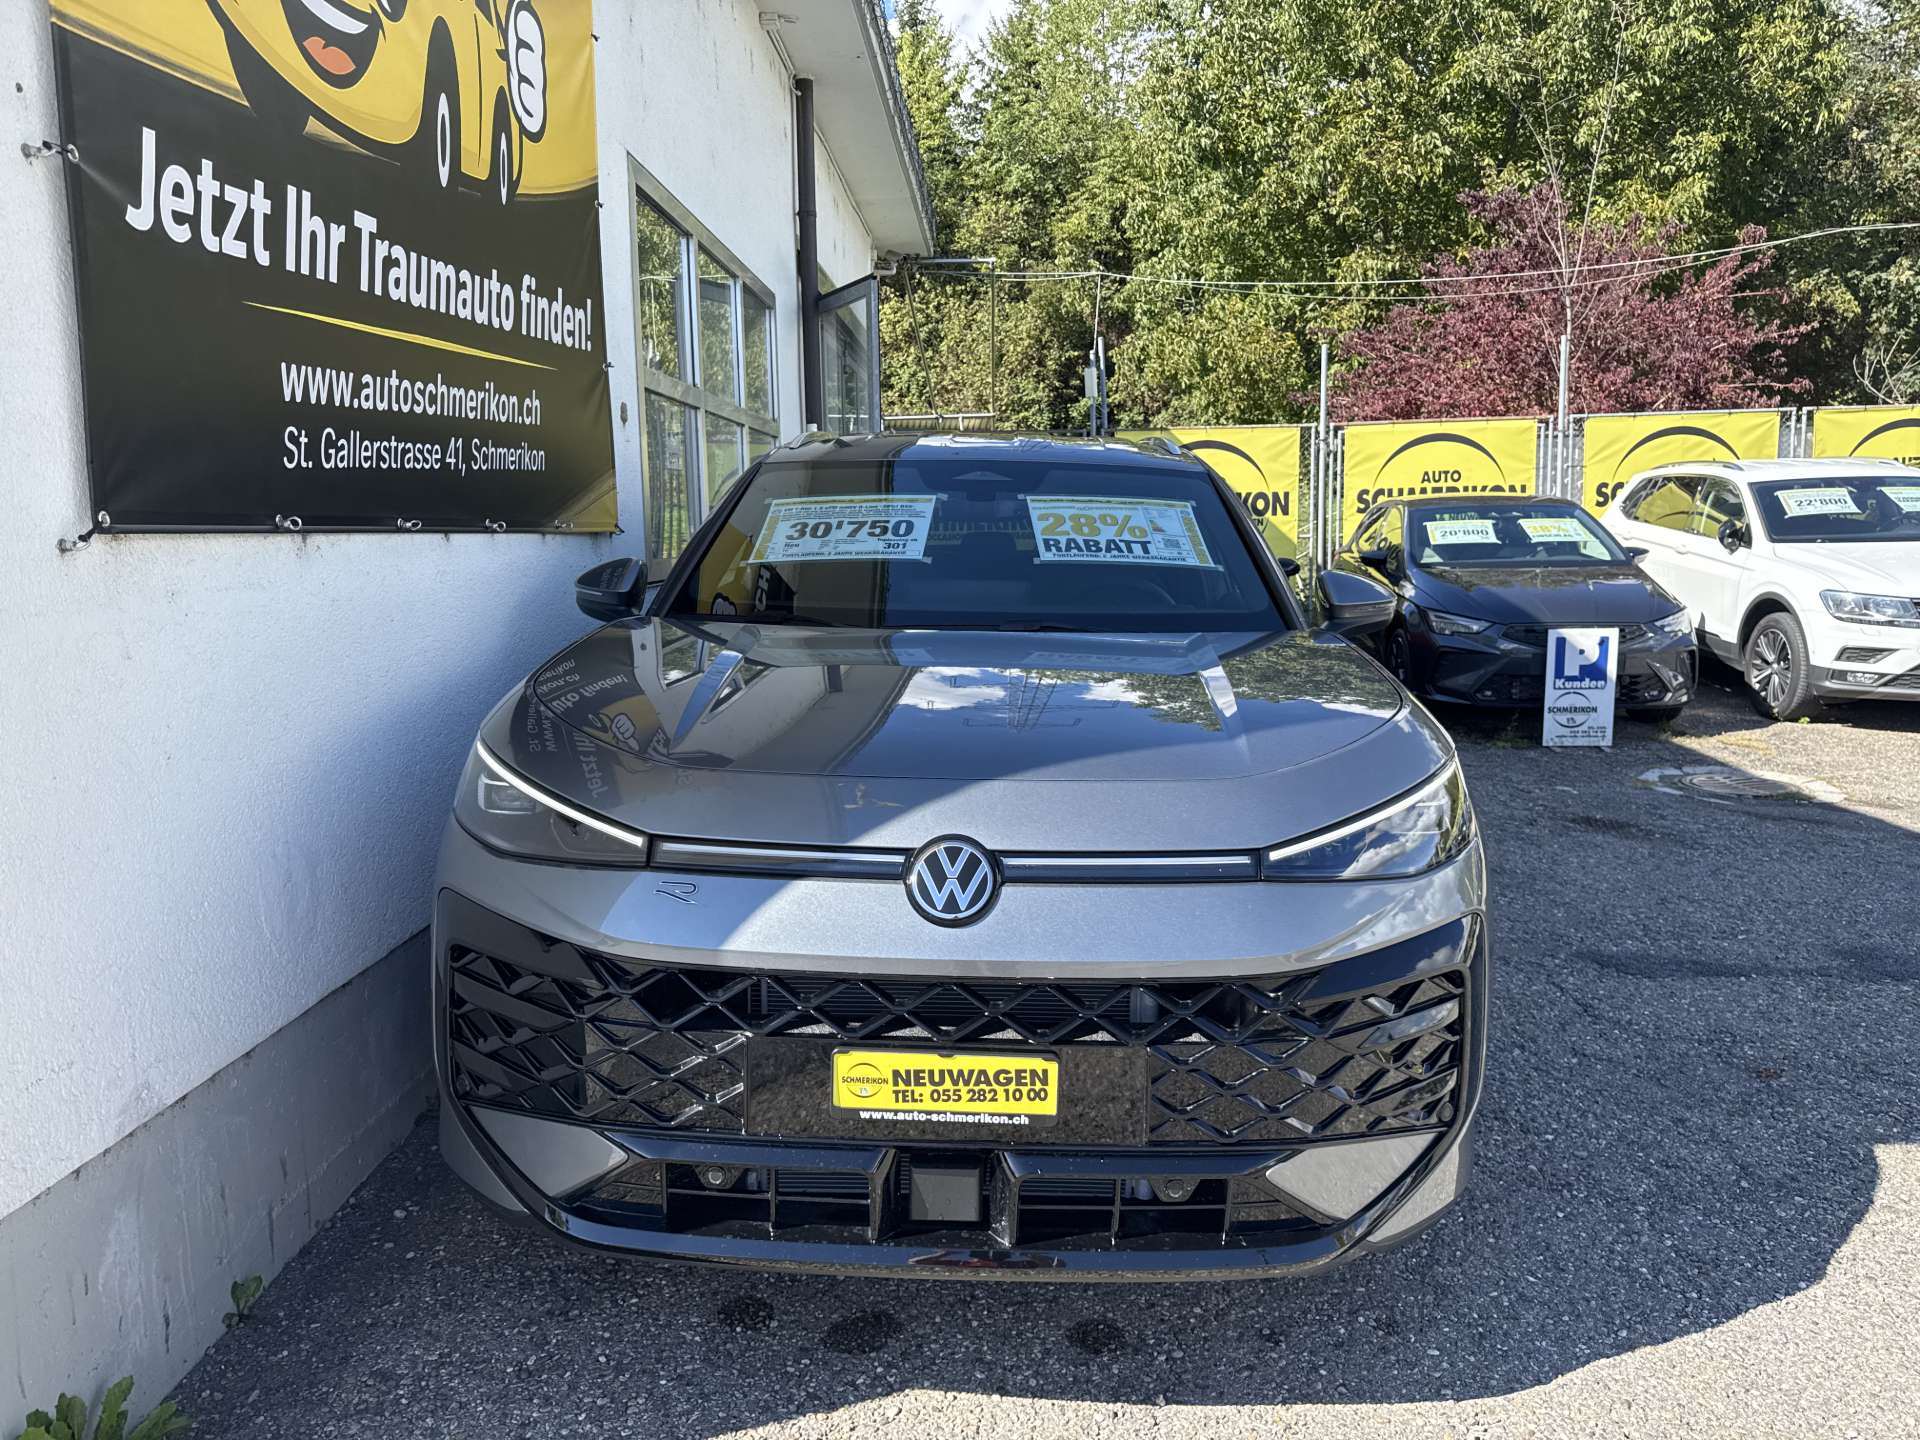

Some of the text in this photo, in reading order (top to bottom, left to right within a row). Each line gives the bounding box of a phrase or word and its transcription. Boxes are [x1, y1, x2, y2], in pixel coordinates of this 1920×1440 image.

[124, 126, 593, 352] Jetzt Ihr Traumauto finden!
[281, 361, 541, 426] www.autoschmerikon.ch
[283, 426, 546, 477] St. Gallerstrasse 41, Schmerikon
[1421, 470, 1462, 483] AUTO
[785, 519, 915, 541] 30'750
[1036, 512, 1149, 539] 28%
[1041, 538, 1152, 554] RABATT
[1555, 677, 1607, 690] Kunden
[1547, 706, 1598, 714] SCHMERIKON
[841, 1075, 889, 1085] SCHMERIKON
[892, 1068, 1049, 1088] NEUWAGEN
[892, 1090, 924, 1103] TEL:
[929, 1089, 962, 1103] 055
[966, 1088, 998, 1103] 282
[859, 1110, 1029, 1125] www.auto-schmerikon.ch
